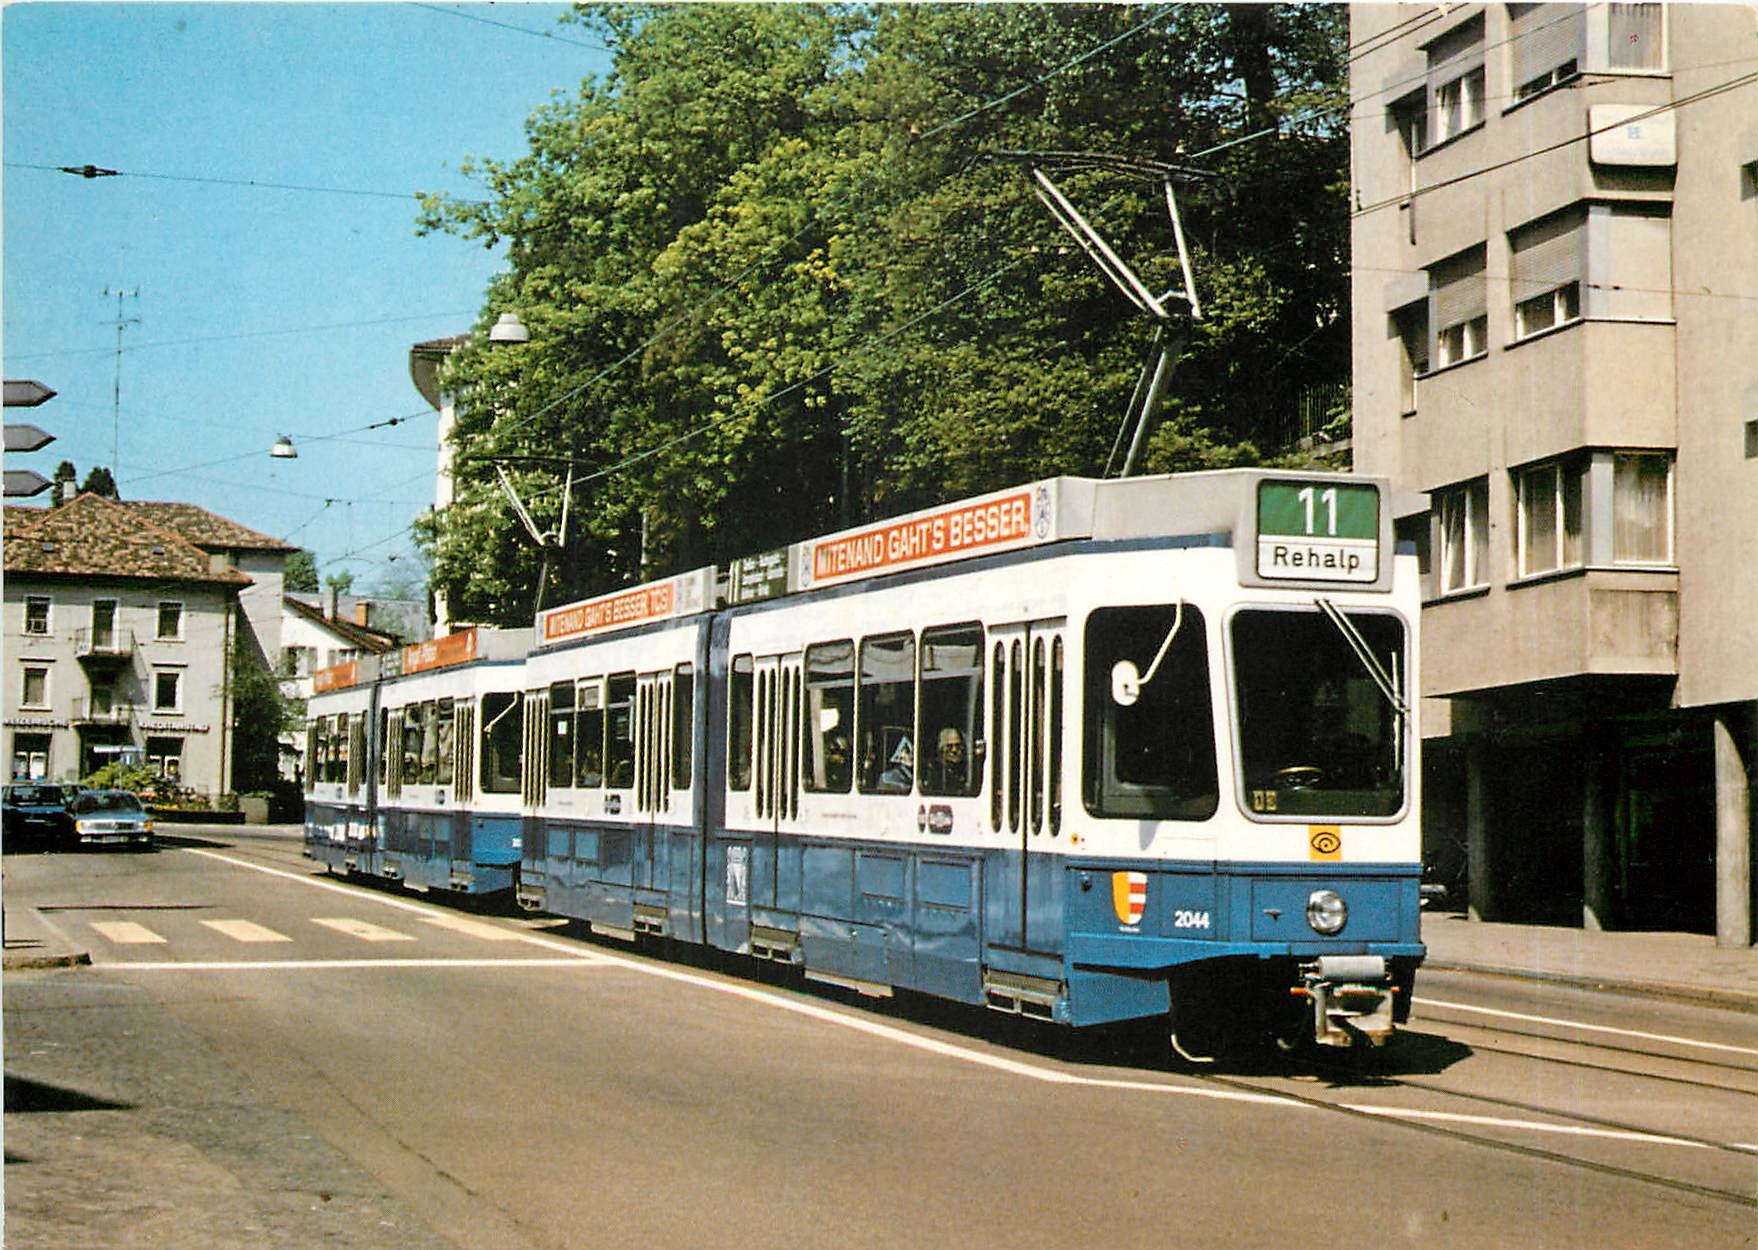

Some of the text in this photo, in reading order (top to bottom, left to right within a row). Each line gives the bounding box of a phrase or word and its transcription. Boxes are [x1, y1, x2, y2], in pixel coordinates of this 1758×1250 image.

[1298, 486, 1337, 535] 11
[816, 536, 884, 576] MITENAND
[888, 518, 946, 560] GAHT'S
[1273, 546, 1360, 575] Rehalp
[1174, 910, 1211, 929] 2044
